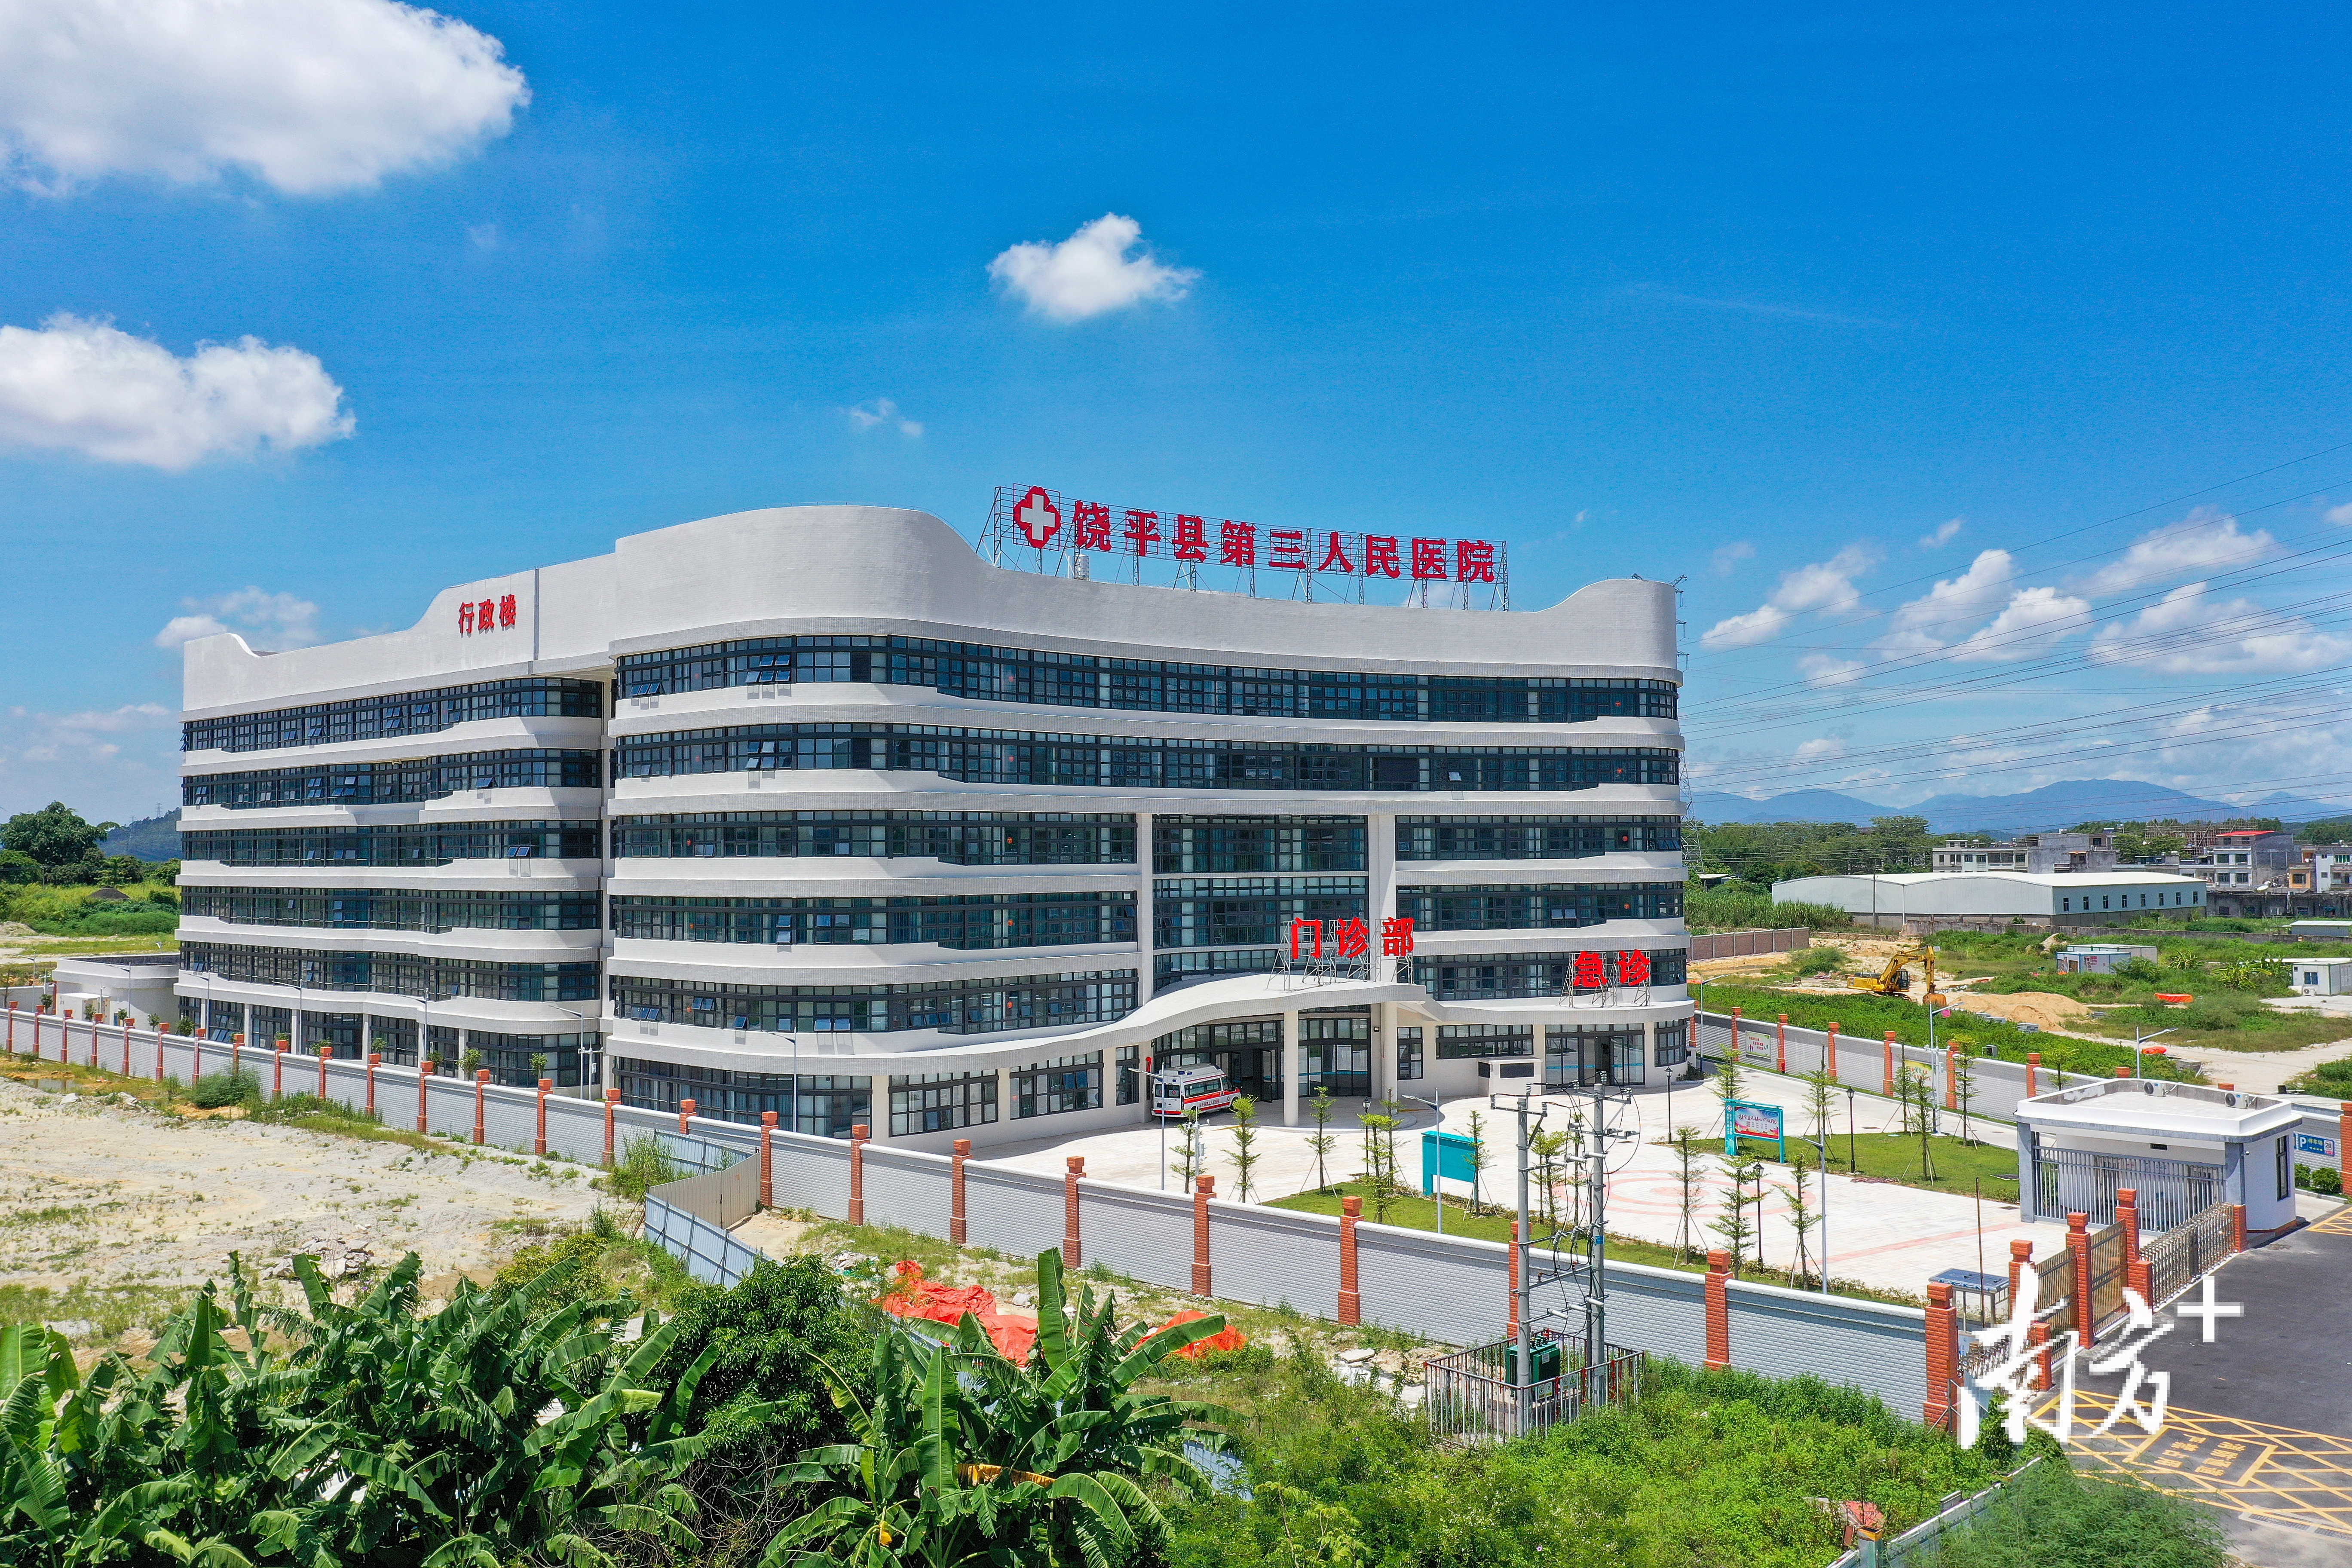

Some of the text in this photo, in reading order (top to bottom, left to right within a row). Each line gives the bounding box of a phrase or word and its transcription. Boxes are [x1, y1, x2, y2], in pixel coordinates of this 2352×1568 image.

[1074, 500, 1494, 582] 饶平县第三人民医院
[458, 594, 516, 634] 行政楼
[1290, 917, 1414, 960] 门诊部
[1572, 949, 1651, 988] 急诊
[2300, 1137, 2306, 1148] P
[2153, 1433, 2207, 1468] 严禁占用
[2194, 1441, 2247, 1476] 消防通道
